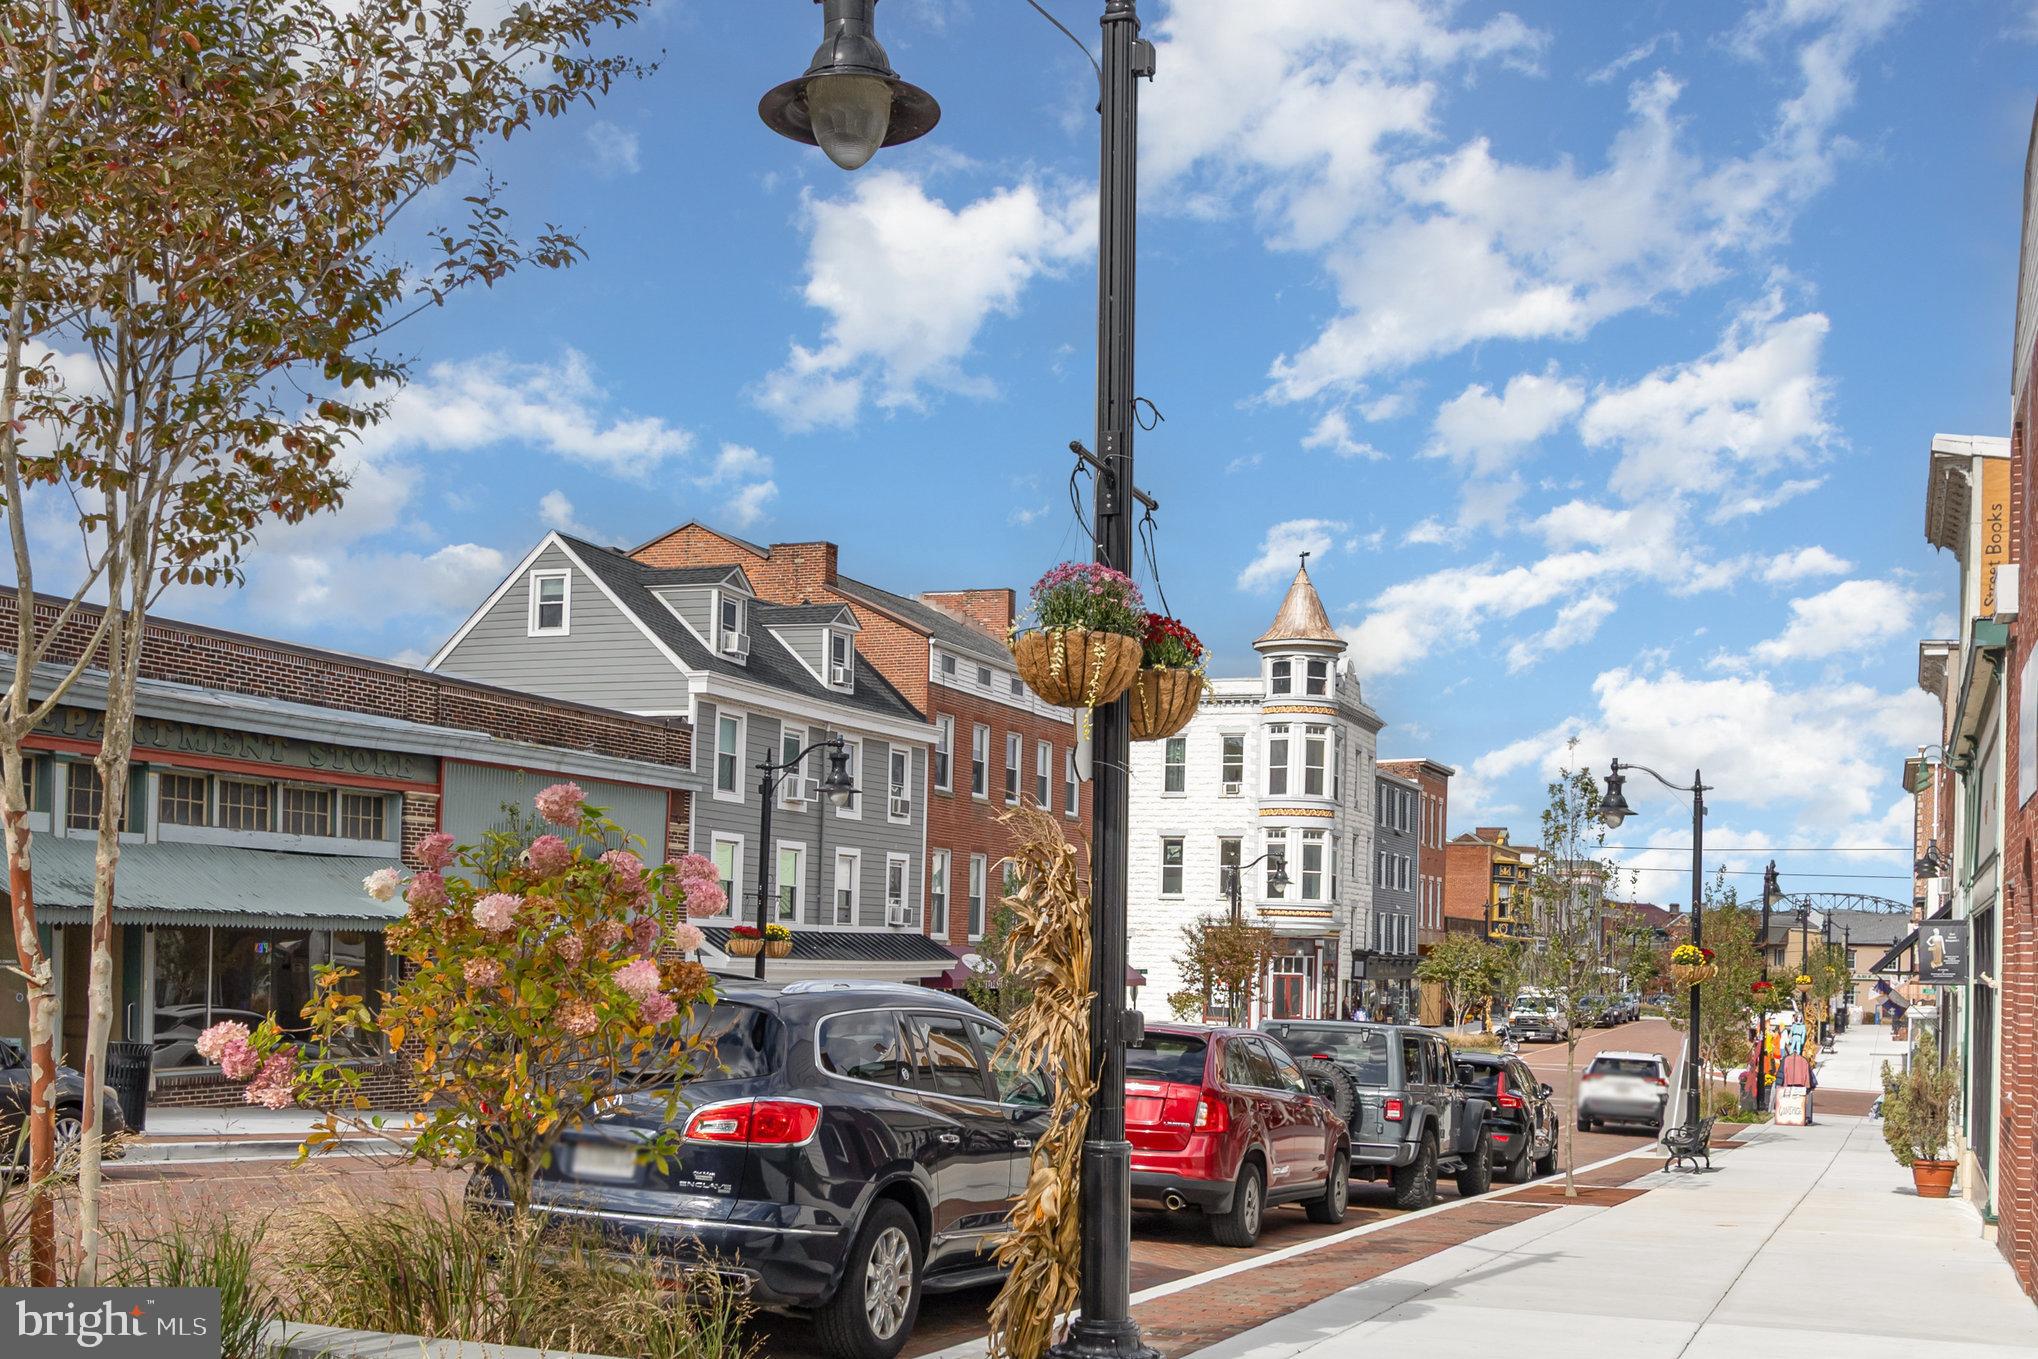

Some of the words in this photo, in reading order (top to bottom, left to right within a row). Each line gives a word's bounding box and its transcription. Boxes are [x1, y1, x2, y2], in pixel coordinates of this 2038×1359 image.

[1985, 503, 2003, 555] Books
[31, 703, 288, 762] EPATMENT
[308, 743, 416, 779] STORE
[679, 1180, 732, 1191] ENCLAVE
